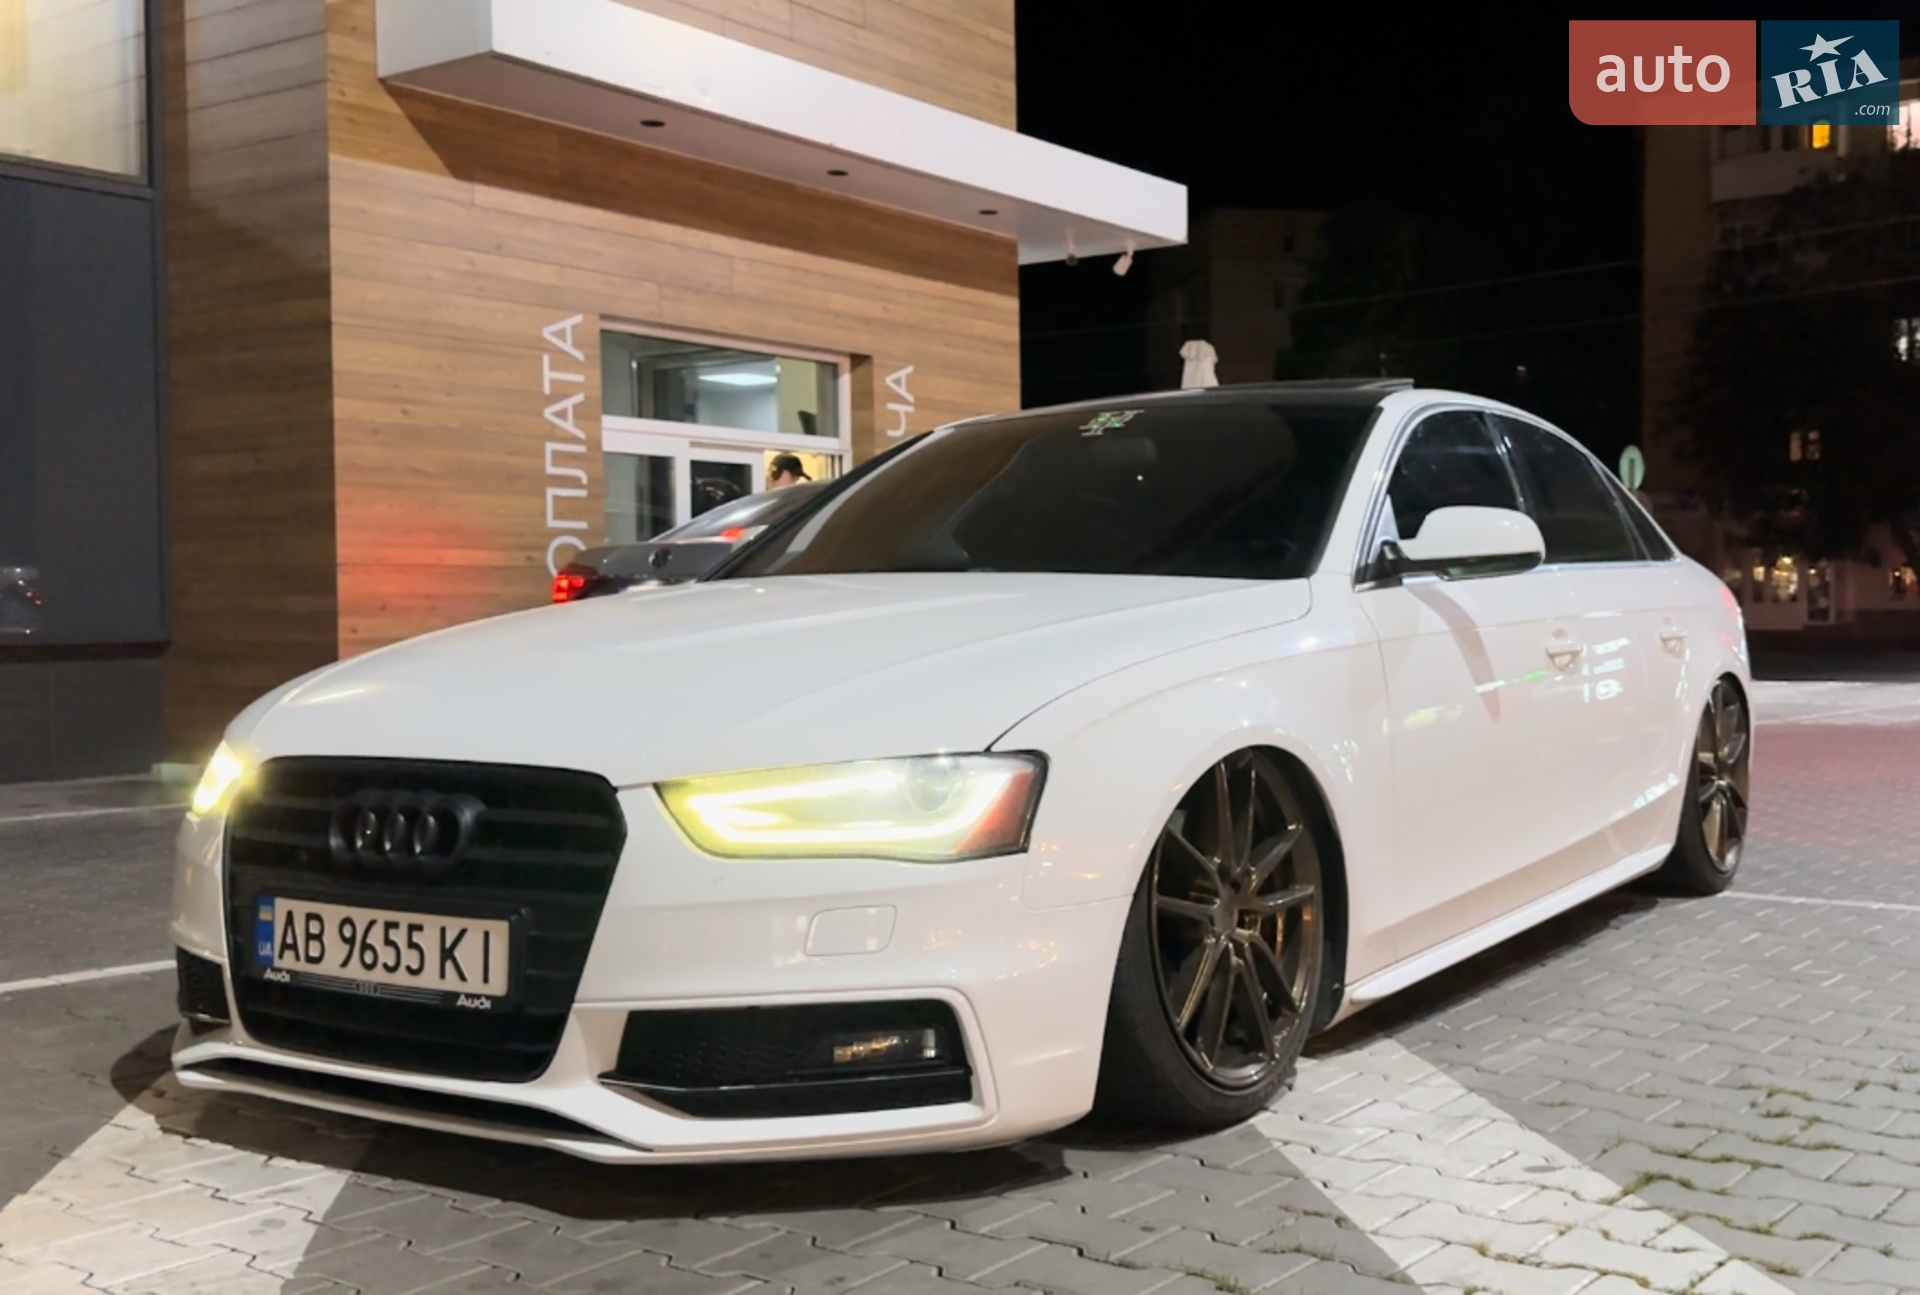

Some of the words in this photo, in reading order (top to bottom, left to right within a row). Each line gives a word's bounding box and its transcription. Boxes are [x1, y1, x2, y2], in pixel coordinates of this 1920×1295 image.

[258, 940, 273, 957] UA
[278, 909, 327, 965] AB
[338, 916, 426, 976] 9655
[439, 925, 490, 985] KI
[263, 967, 291, 983] Audi
[455, 993, 492, 1010] Audi
